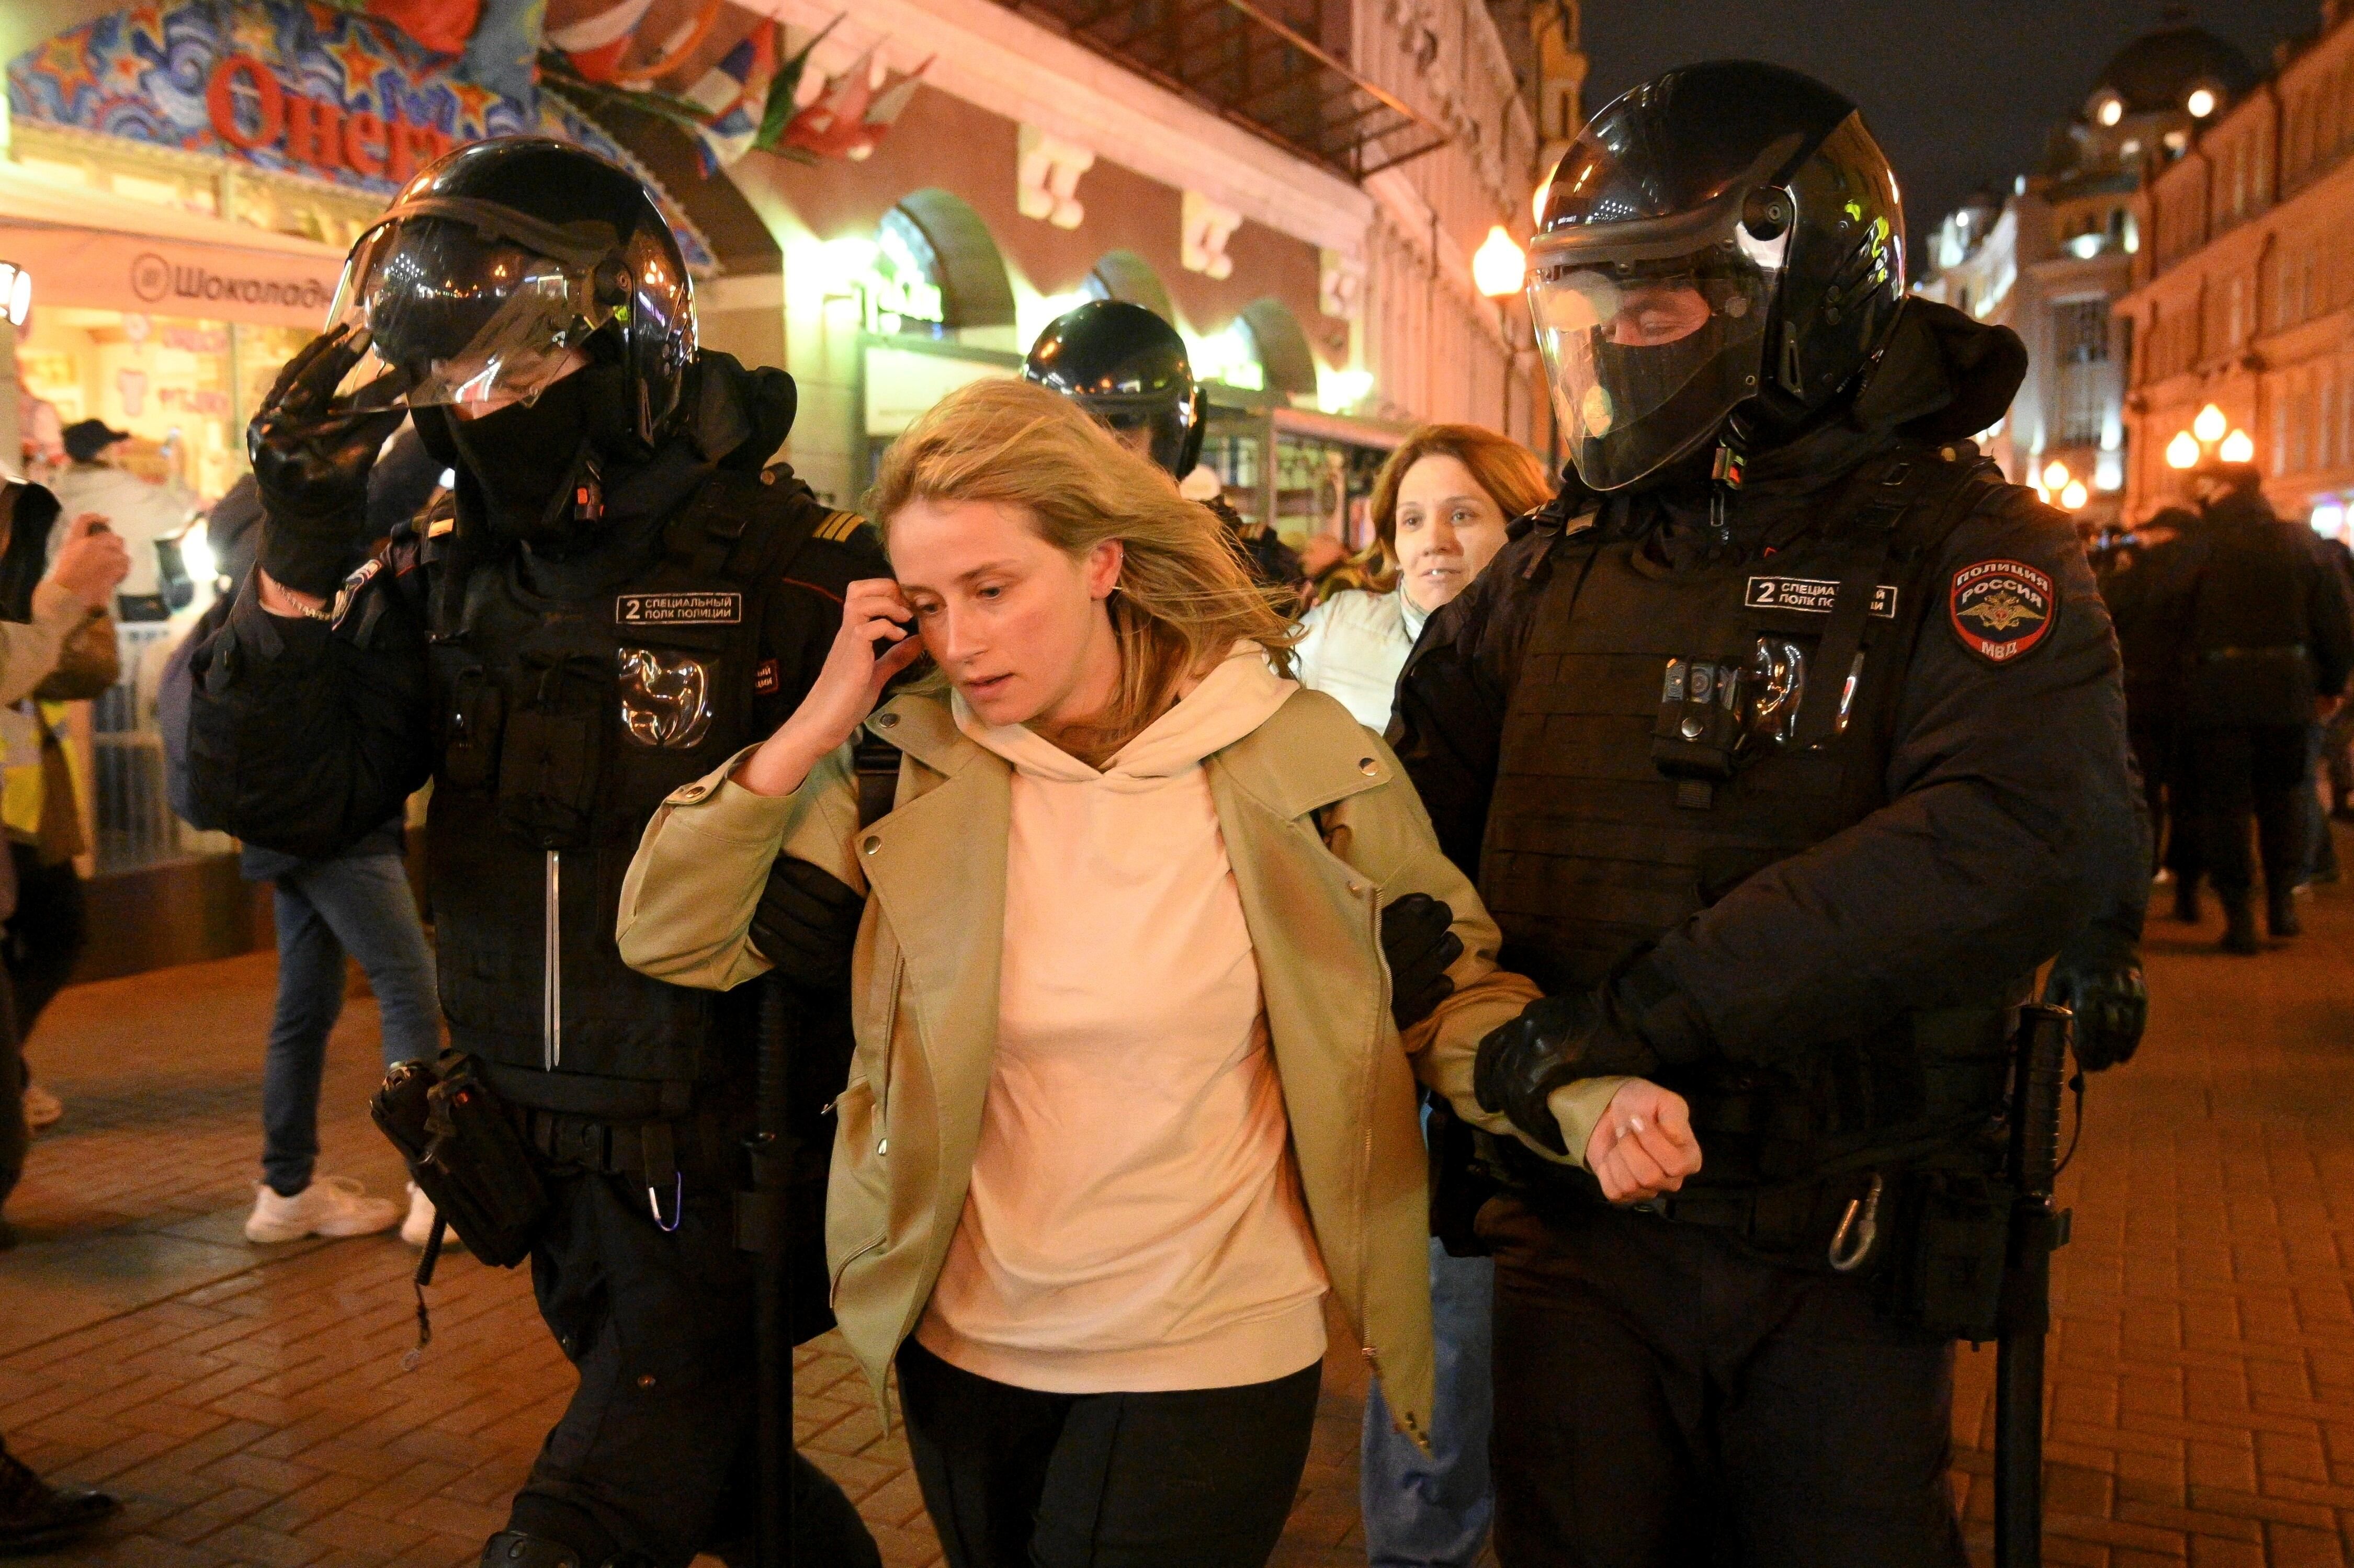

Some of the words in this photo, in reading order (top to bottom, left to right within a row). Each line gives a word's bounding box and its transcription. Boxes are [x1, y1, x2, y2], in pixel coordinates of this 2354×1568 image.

[1957, 563, 2048, 592] ПОЛИЦИЯ
[1756, 582, 1775, 602] 2
[1779, 594, 1816, 606] ПОЛК
[1962, 579, 2042, 608] РОССИЯ
[626, 599, 640, 619] 2
[644, 597, 731, 609] СПЕЦИАЛЬНЫЙ
[645, 609, 674, 619] ПОЛК
[677, 608, 731, 619] ПОЛИЦИИ
[1982, 641, 2017, 658] МВД
